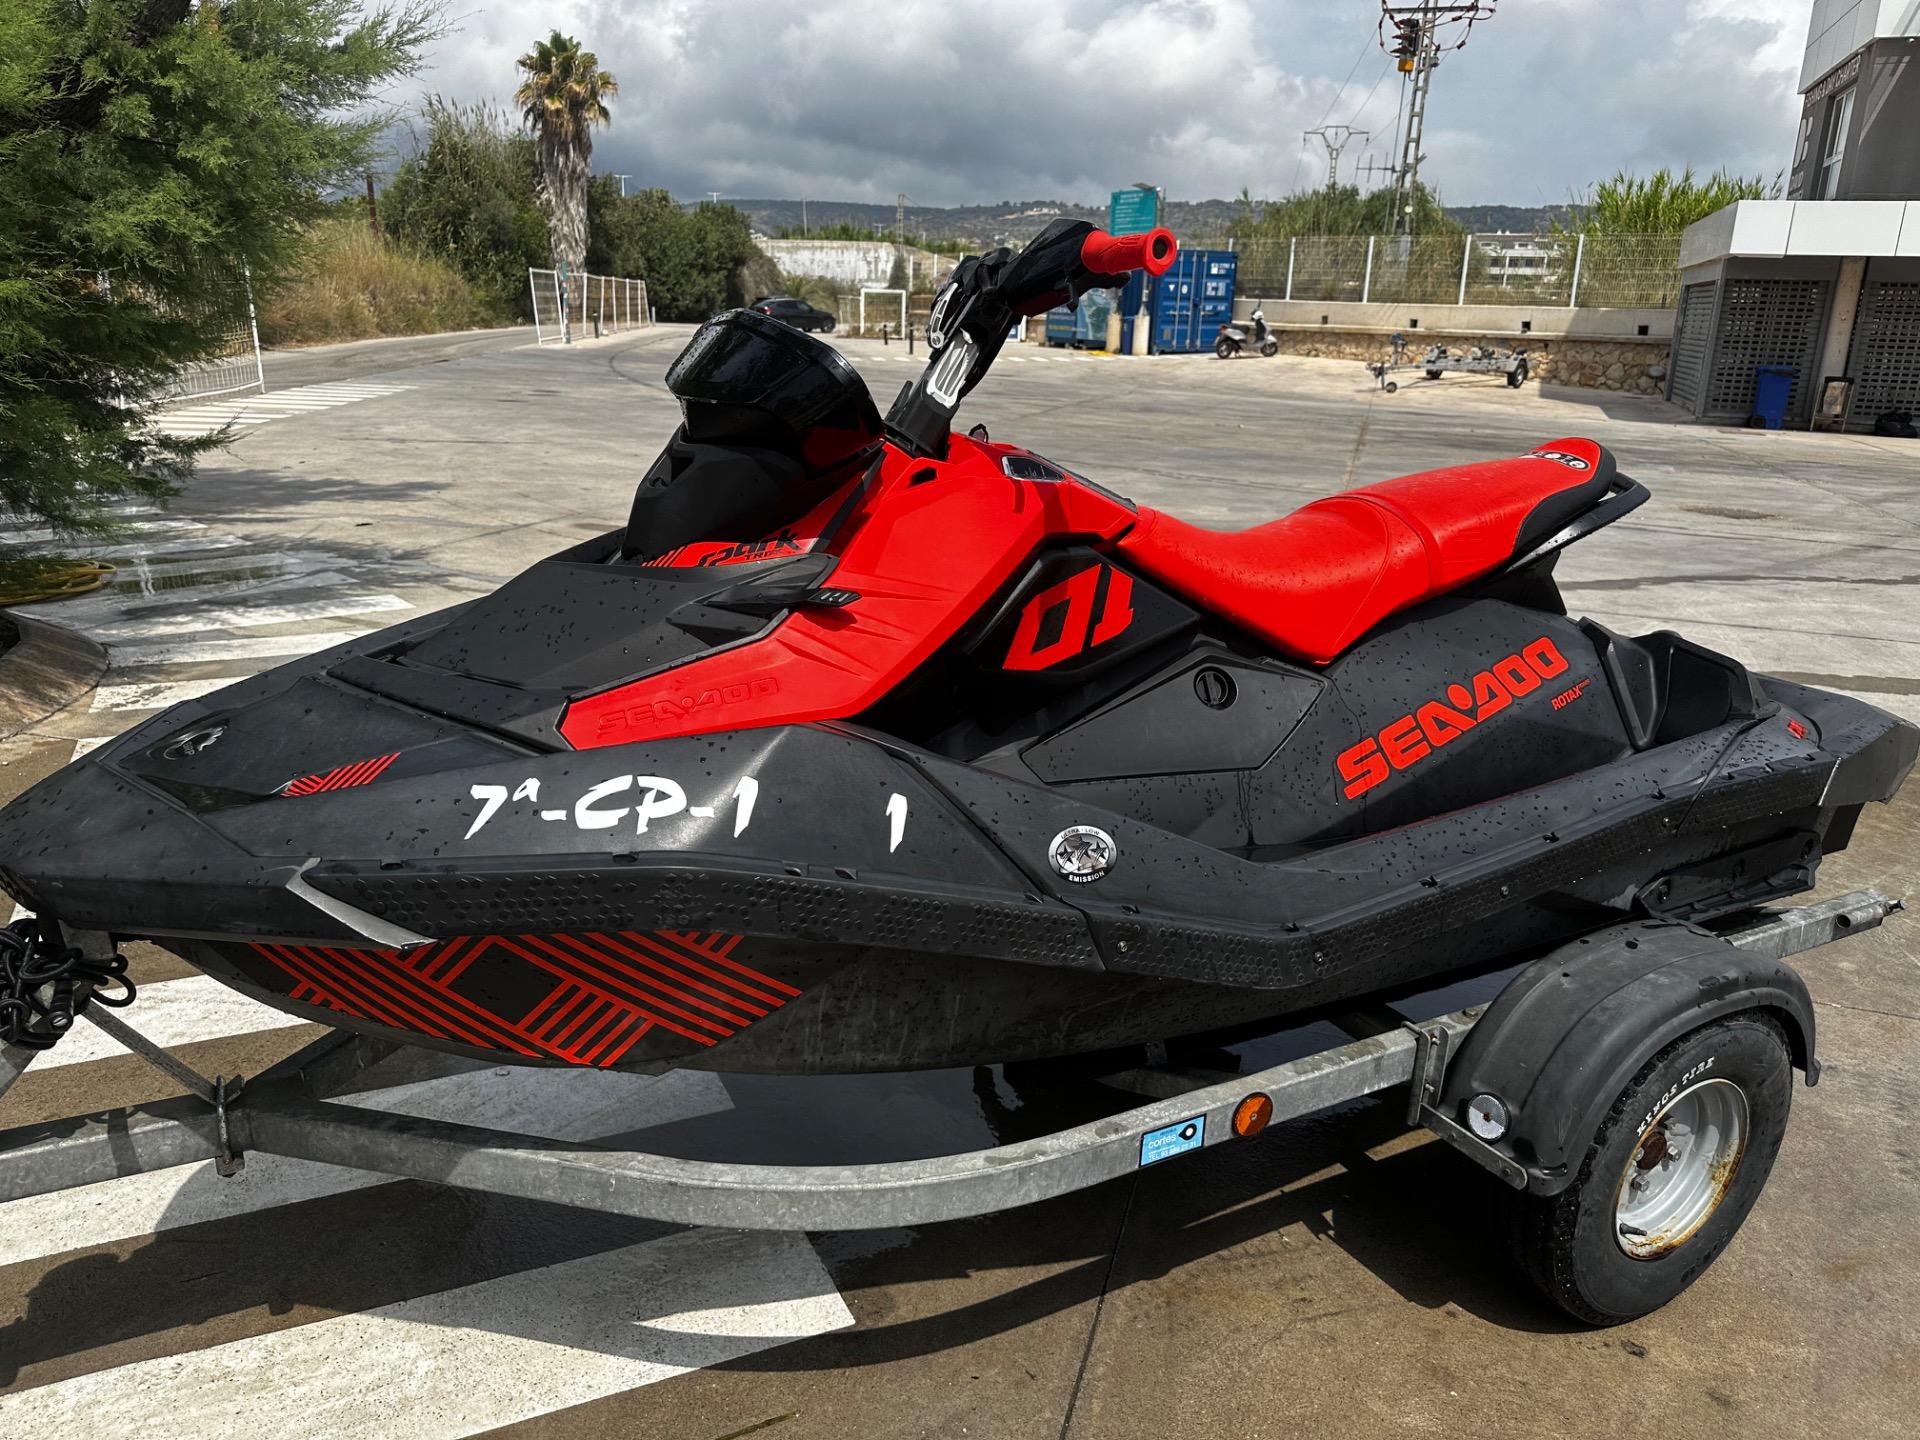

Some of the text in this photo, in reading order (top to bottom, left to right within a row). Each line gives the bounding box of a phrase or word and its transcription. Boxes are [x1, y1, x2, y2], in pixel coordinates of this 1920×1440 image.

[1551, 685, 1583, 711] ROTAX
[885, 792, 908, 853] 1
[1068, 870, 1105, 883] EMISSION
[1636, 1056, 1715, 1137] KINGS TIRE
